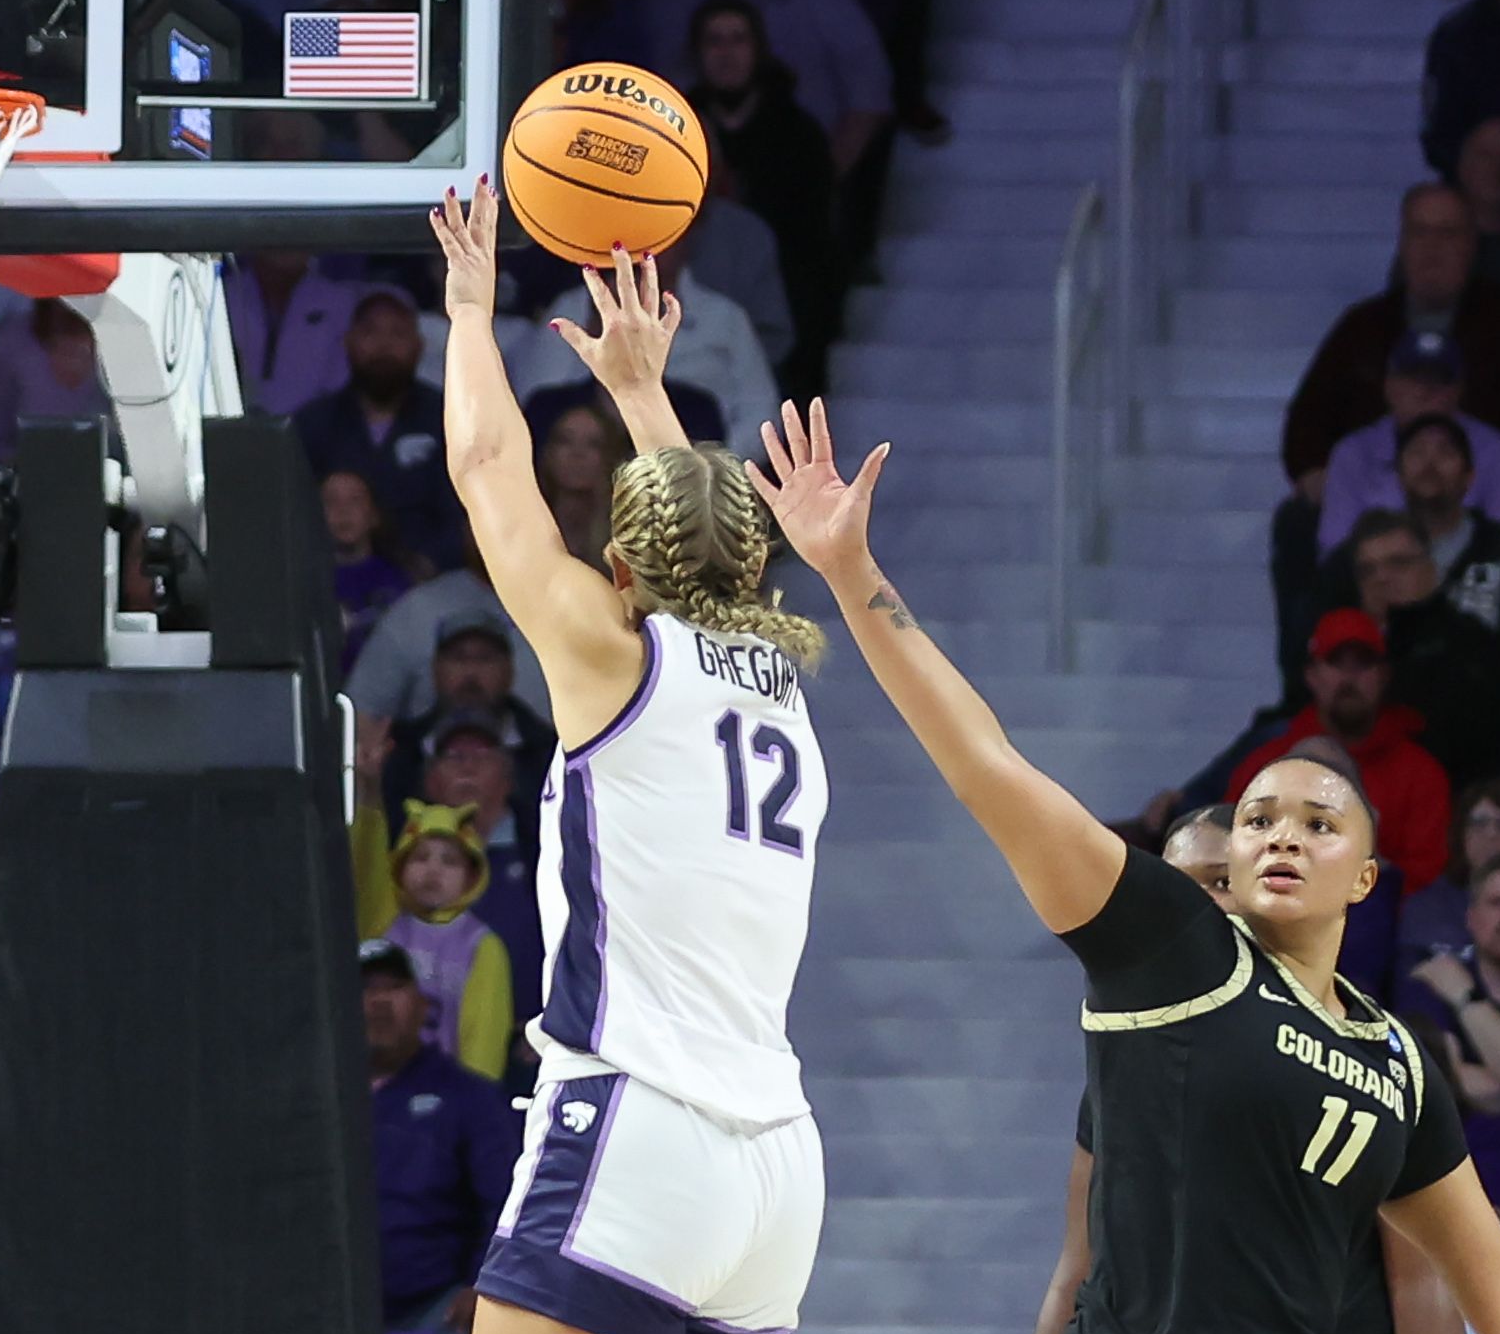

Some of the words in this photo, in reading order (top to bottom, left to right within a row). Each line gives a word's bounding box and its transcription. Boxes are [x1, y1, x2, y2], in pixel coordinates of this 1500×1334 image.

[563, 74, 685, 135] Wilson
[714, 708, 804, 859] 12
[1276, 1023, 1406, 1122] COLORADO
[1301, 1094, 1379, 1187] 11
